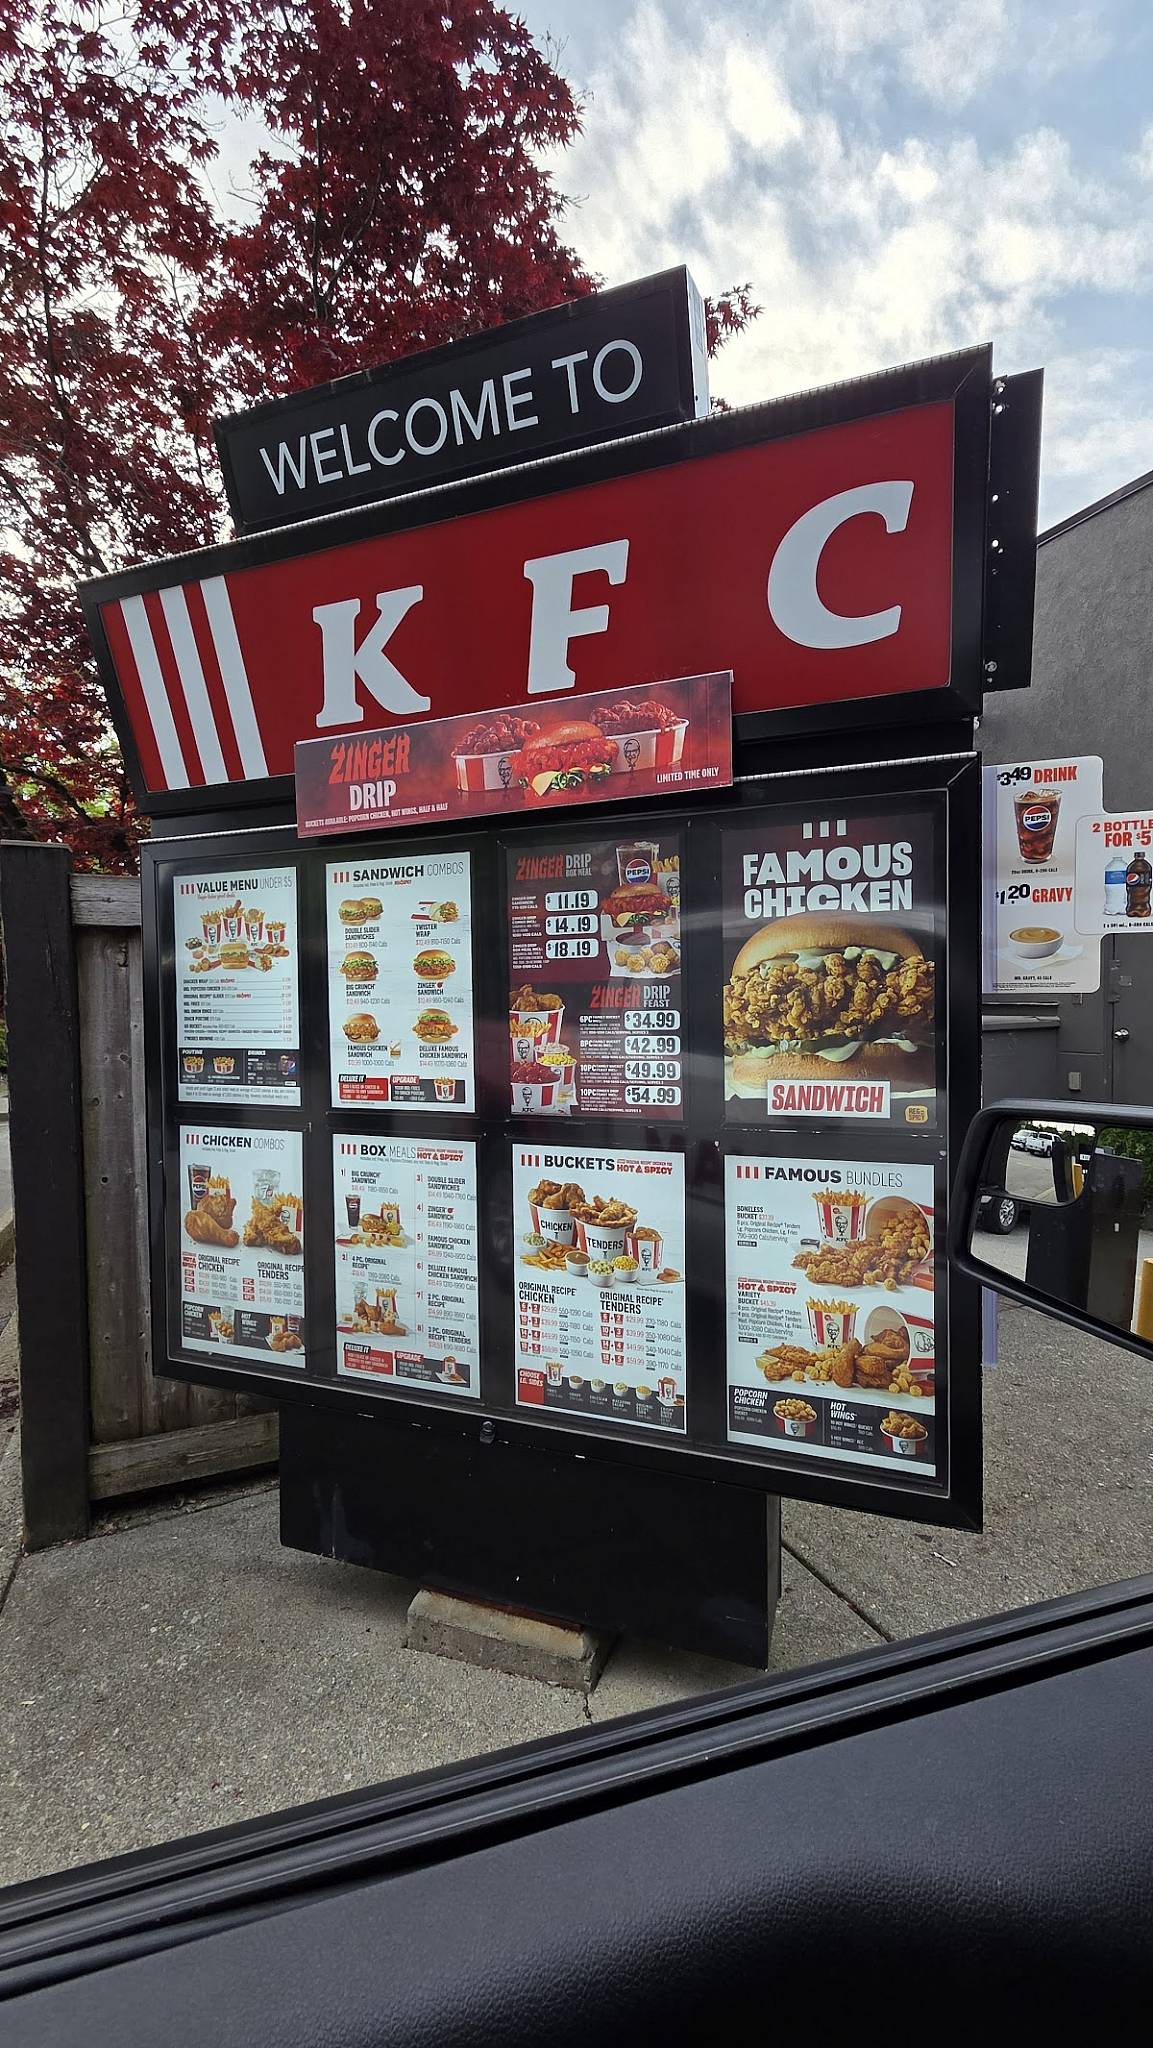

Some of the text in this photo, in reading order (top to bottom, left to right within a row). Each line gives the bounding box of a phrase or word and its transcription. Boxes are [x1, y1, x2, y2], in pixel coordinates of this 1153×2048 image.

[259, 339, 643, 495] WELCOME TO
[329, 731, 411, 784] ZINGER
[657, 766, 719, 783] LIMITED TIME ONLY
[996, 765, 1078, 787] $3.49 DRINK
[350, 780, 397, 811] DRIP
[305, 818, 325, 828] BUCKETS
[349, 814, 369, 823] POPCORN
[370, 811, 391, 821] CHICKEN,
[391, 810, 401, 818] HOT
[401, 807, 418, 817] WINGS,
[419, 805, 431, 814] HALF
[432, 804, 436, 812] &
[436, 802, 448, 812] HALF
[1025, 814, 1050, 822] PEPSI
[1092, 819, 1153, 833] 2 BOTTLE
[1105, 830, 1152, 848] FOR $5
[516, 853, 564, 881] ZINGER
[565, 853, 592, 869] DRIP
[743, 841, 913, 886] FAMOUS
[353, 861, 464, 881] SANDWICH COMBOS
[565, 867, 592, 878] BOX MEAL
[627, 868, 649, 876] PEPSI
[197, 875, 293, 893] VALUE MENU UNDER $5
[547, 893, 590, 909] $11.19
[744, 878, 912, 919] CHICKEN
[995, 883, 1073, 905] $1.20 GRAVY
[547, 916, 591, 933] $14.19
[345, 933, 375, 941] SANDWICHES
[416, 930, 431, 938] WRAP
[547, 941, 591, 957] $18.19
[590, 984, 641, 1008] ZINGER
[643, 985, 670, 999] DRIP
[643, 999, 670, 1008] FEAST
[626, 1012, 675, 1028] $34.99
[627, 1037, 676, 1053] $42.99
[627, 1063, 676, 1078] $49.99
[627, 1087, 676, 1103] $54.99
[772, 1083, 884, 1112] SANDWICH
[202, 1134, 285, 1150] CHICKEN COMBOS
[361, 1144, 386, 1156] BOX
[389, 1145, 416, 1159] MEALS
[417, 1152, 463, 1161] HOT SPICY
[544, 1154, 615, 1171] BUCKETS
[616, 1164, 673, 1175] HOT & SPICY
[765, 1167, 903, 1188] FAMOUS BUNDLES
[428, 1183, 460, 1191] SANDWICHES
[540, 1219, 572, 1232] CHICKEN
[428, 1235, 470, 1245] FAMOUS CHICKEN
[587, 1237, 624, 1250] TENDERS
[198, 1254, 240, 1266] ORIGINAL RECIPE
[257, 1261, 305, 1273] ORIGINAL RECIPE
[364, 1257, 387, 1265] ORIGINAL
[198, 1262, 225, 1273] CHICKEN
[258, 1269, 289, 1280] TENDERS
[428, 1264, 467, 1274] DELUXE FAMOUS
[428, 1271, 477, 1282] CHICKEN SANDWICH
[519, 1281, 577, 1296] ORIGINAL RECIPE
[758, 1284, 765, 1292] &
[767, 1285, 797, 1294] SPICY
[428, 1300, 446, 1308] RECIPE
[441, 1295, 465, 1303] ORIGINAL
[519, 1290, 555, 1304] CHICKEN
[600, 1291, 663, 1306] ORIGINAL RECIPE
[184, 1304, 204, 1312] POPCORN
[600, 1300, 641, 1314] TENDERS
[441, 1329, 466, 1337] ORIGINAL
[448, 1336, 471, 1344] TENDERS
[397, 1353, 421, 1361] UPGRADE
[520, 1371, 540, 1380] CHOOSE
[528, 1379, 544, 1387] SIDES
[734, 1388, 768, 1400] POPCORN
[734, 1396, 765, 1407] CHICKEN
[830, 1401, 847, 1411] HOT
[831, 1410, 855, 1420] WINGS
